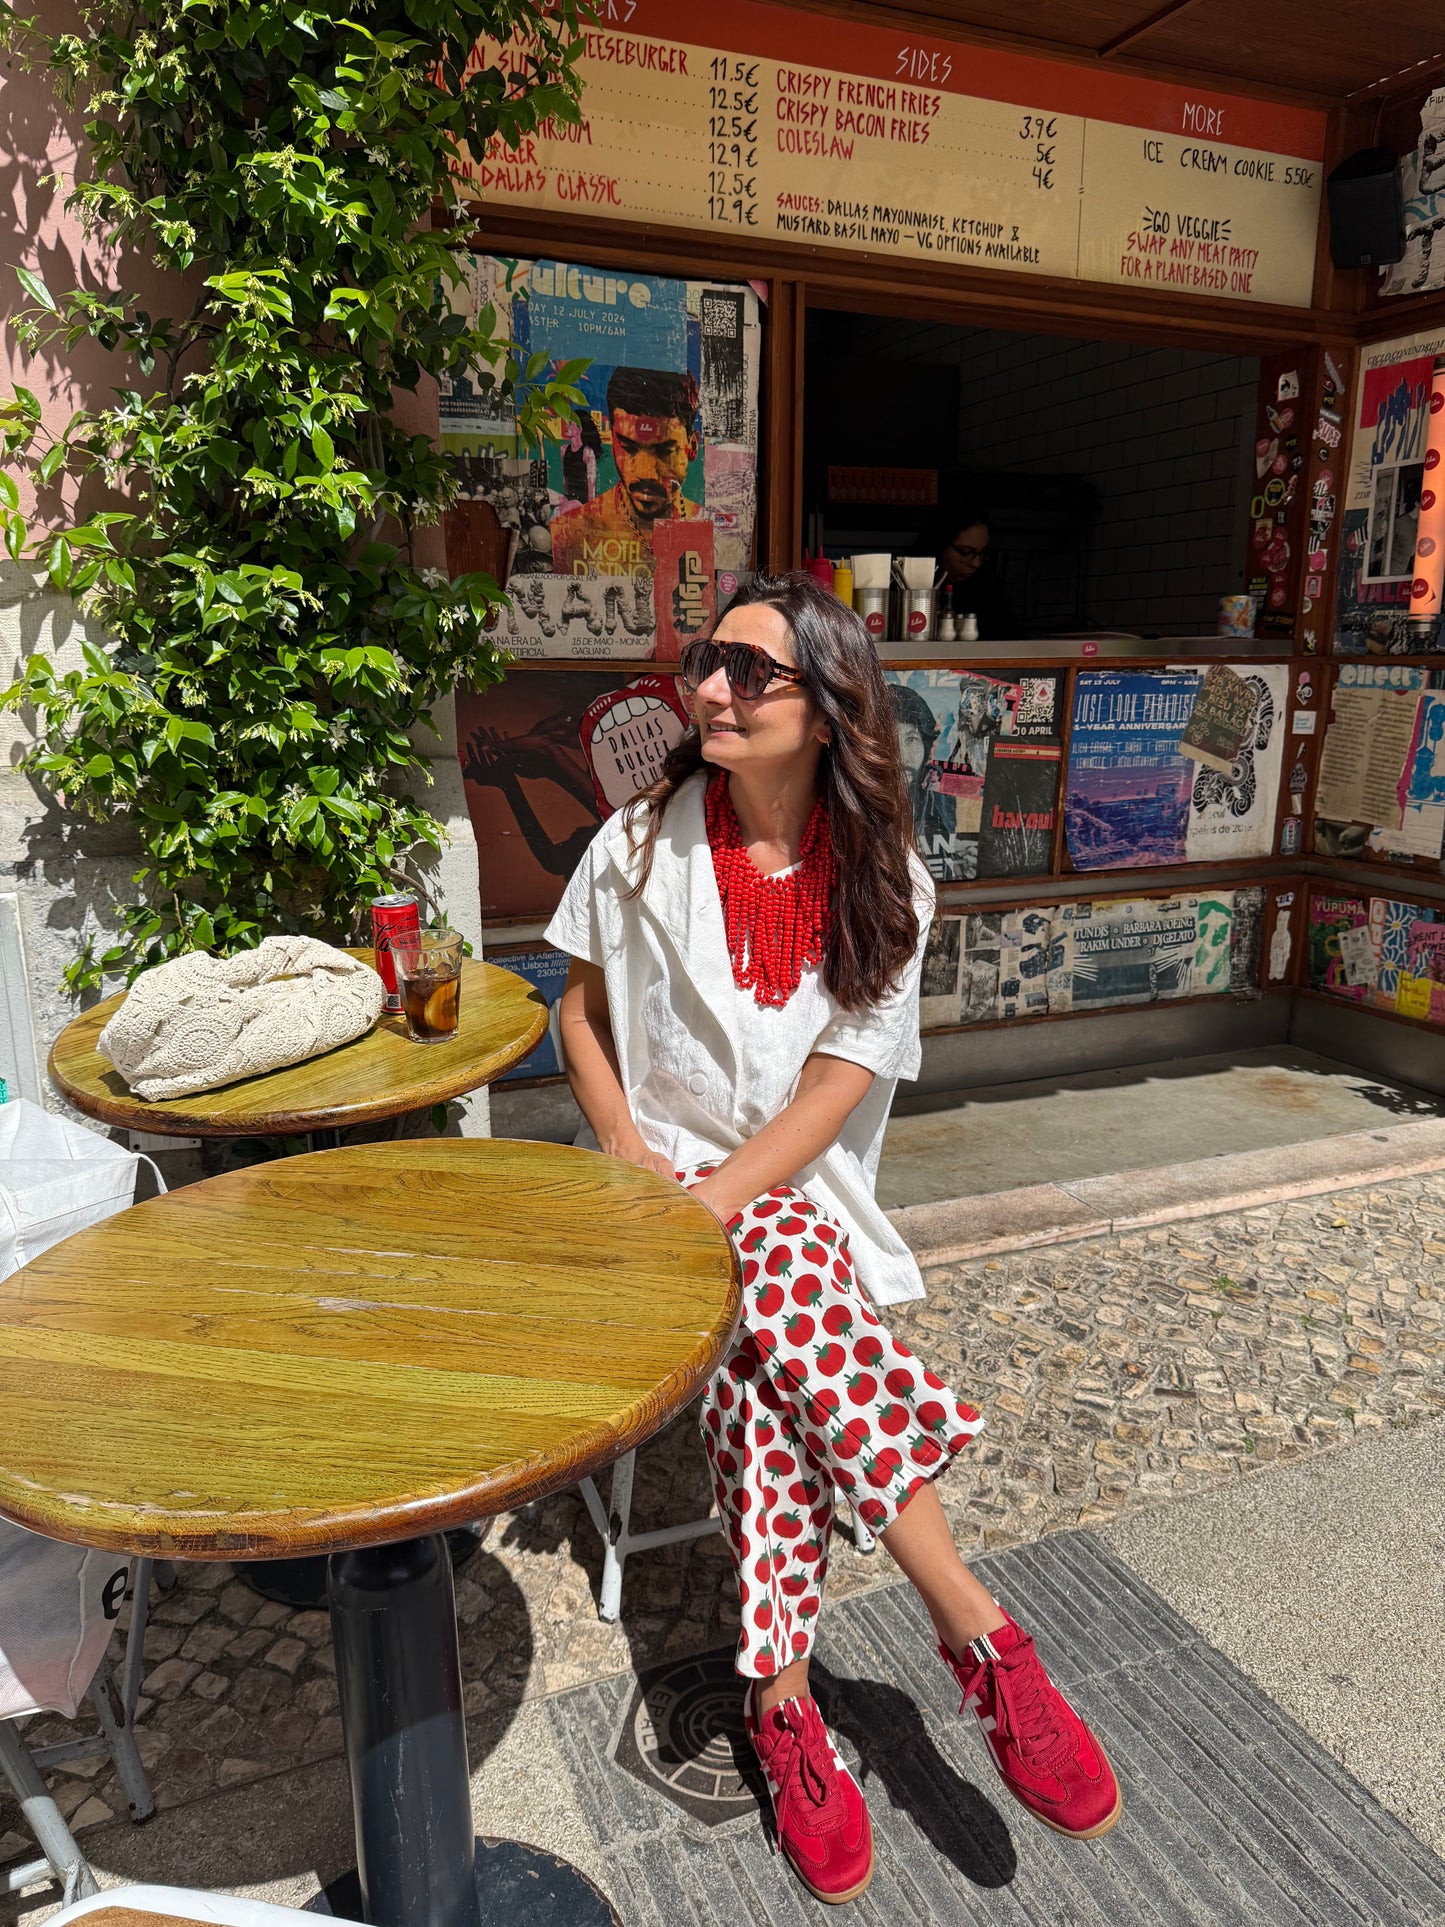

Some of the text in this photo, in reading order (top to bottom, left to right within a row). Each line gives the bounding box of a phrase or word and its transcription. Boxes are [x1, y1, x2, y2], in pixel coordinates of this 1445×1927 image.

[896, 47, 952, 84] SIDES
[709, 87, 758, 114] 12.5€
[777, 68, 941, 118] CRISPY FRENCH FRIES
[709, 116, 757, 142] 12.5€
[776, 97, 930, 144] CRISPY BACON FRIES
[1019, 116, 1057, 139] 3.9€
[1182, 102, 1225, 136] MORE
[777, 128, 855, 160] COLESLAW
[1036, 144, 1056, 165] 5€
[1144, 139, 1164, 163] ICE
[1180, 148, 1228, 174] CREAM
[1234, 159, 1274, 182] COOKIE
[481, 166, 546, 193] DALLAS
[557, 173, 622, 206] CLASSIC
[708, 171, 757, 198] 12.5€
[1032, 167, 1054, 189] 4€
[708, 196, 758, 225] 12.9€
[776, 192, 824, 213] SAUCES:
[952, 217, 1003, 240] KETCHUP
[1153, 211, 1222, 242] GO VEGGIE
[834, 222, 868, 241] BASIL
[870, 226, 900, 245] MAYO
[917, 232, 933, 249] VG
[936, 237, 982, 255] OPTIONS
[985, 242, 1040, 264] AVAILABLE
[1127, 231, 1259, 270] SWAP ANY MEAT PATTY
[1121, 256, 1253, 293] FOR A PLANT-BASED ONE
[553, 305, 565, 317] 12
[602, 312, 626, 324] 2024
[578, 322, 626, 338] 10PM/6AM
[582, 539, 643, 562] MOTEL
[1074, 694, 1103, 723] JUST
[1108, 694, 1137, 723] LOOK
[609, 717, 664, 754] DALLAS
[1028, 726, 1053, 735] APRIL
[1118, 722, 1189, 731] ANNIVERSAR
[632, 763, 664, 791] CLU
[1080, 938, 1110, 953] RAKIM
[1111, 935, 1142, 950] UNDER
[488, 954, 527, 964] Collective
[522, 961, 550, 970] Lisboa
